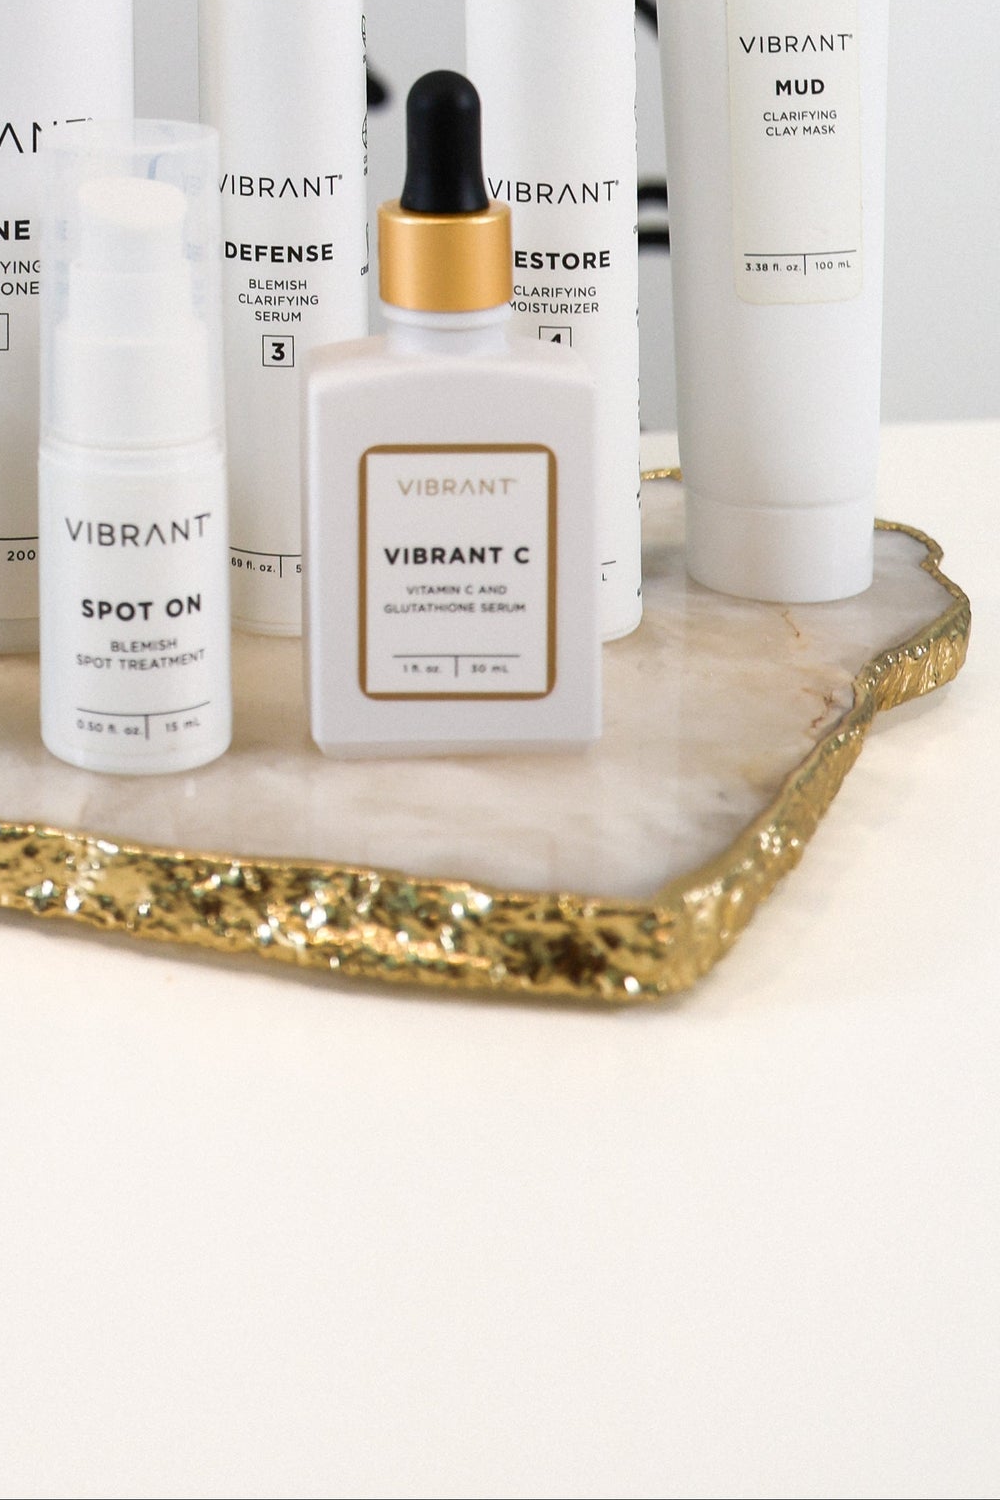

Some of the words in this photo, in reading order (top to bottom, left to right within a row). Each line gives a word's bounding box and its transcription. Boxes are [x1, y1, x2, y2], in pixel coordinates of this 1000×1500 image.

[775, 78, 825, 96] MUD
[762, 109, 837, 122] CLARIFYING
[765, 126, 798, 137] CLAY
[802, 124, 836, 136] MASK
[224, 240, 334, 264] DEFENSE
[514, 249, 611, 271] ESTORE
[745, 262, 769, 272] 3.38
[815, 260, 834, 271] 100
[837, 259, 852, 269] mL
[248, 278, 307, 291] BLEMISH
[511, 283, 599, 299] CLARIFYING
[238, 292, 319, 307] CLARIFYING
[254, 310, 302, 323] SERUM
[271, 342, 286, 362] 3
[7, 549, 36, 562] 200
[383, 546, 503, 566] VIBRANT
[513, 546, 530, 565] C
[246, 559, 256, 571] fl.
[259, 563, 276, 573] oz.
[406, 584, 461, 596] VITAMIN
[465, 584, 474, 596] C
[478, 584, 508, 596] AND
[81, 598, 154, 622] SPOT
[165, 593, 201, 619] ON
[383, 602, 476, 614] GLUTATHIONE
[480, 601, 527, 614] SERUM
[110, 638, 178, 653] BLEMISH
[77, 653, 112, 670] SPOT
[120, 648, 205, 671] TREATMENT
